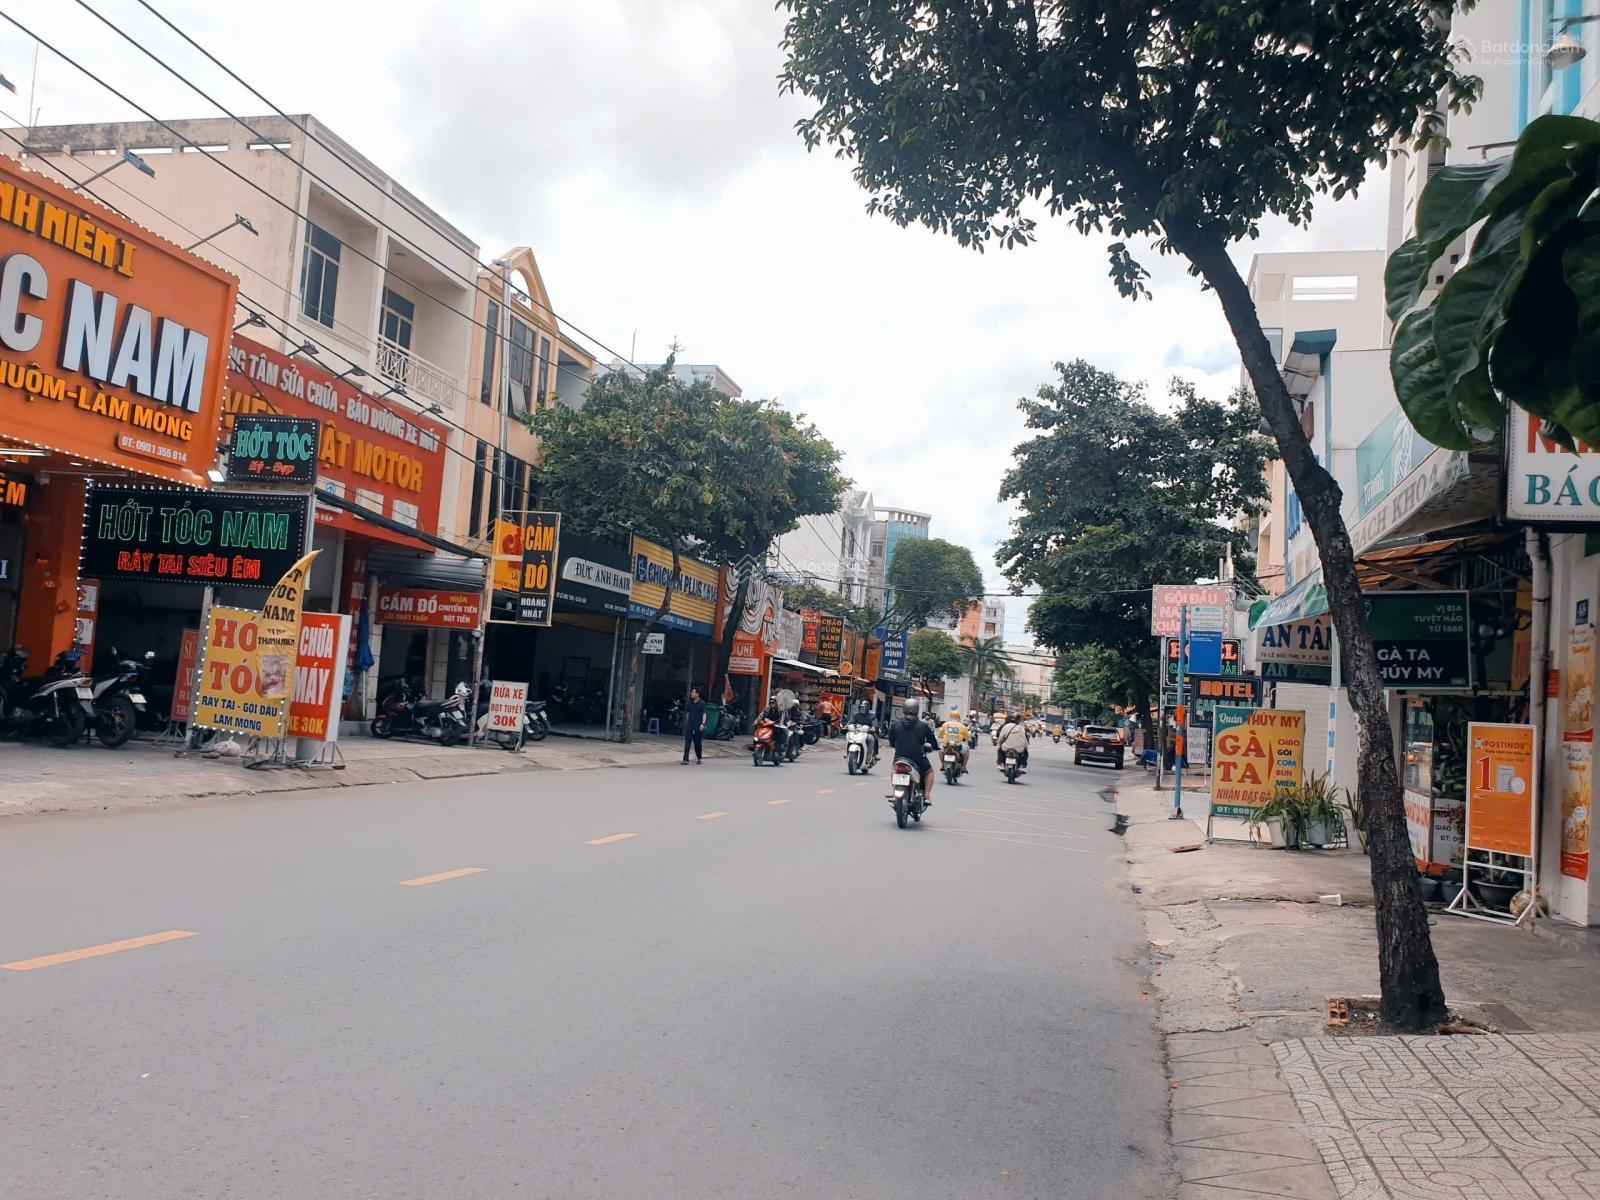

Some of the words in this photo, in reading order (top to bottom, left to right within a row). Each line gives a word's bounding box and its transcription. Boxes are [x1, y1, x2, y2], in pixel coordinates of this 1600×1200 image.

[62, 277, 209, 414] NAM
[250, 353, 278, 388] TÂM
[405, 423, 418, 445] XE
[235, 423, 272, 459] HỚT
[276, 424, 312, 461] TÓC
[353, 439, 424, 493] MOTOR
[98, 499, 154, 542] HỚT
[160, 501, 213, 546] TÓC
[220, 510, 290, 550] NAM
[525, 516, 555, 551] CẦM
[158, 553, 184, 575] TAI
[524, 554, 548, 589] ĐỒ
[595, 569, 612, 585] ANH
[612, 572, 631, 591] HAIR
[263, 605, 295, 622] NAM
[1262, 624, 1293, 648] AN
[1376, 646, 1403, 661] GÀ
[1406, 648, 1431, 661] TA
[290, 661, 330, 706] MÁY
[1417, 667, 1444, 679] MY
[513, 688, 524, 699] XE
[1200, 680, 1254, 698] HOTEL
[221, 698, 236, 710] TAI
[301, 717, 324, 735] 30K
[494, 715, 517, 727] 30K
[1219, 712, 1242, 724] Quán
[1280, 715, 1301, 728] MY
[1218, 730, 1266, 758] GÀ
[1485, 740, 1525, 749] POSTINOR
[1217, 761, 1262, 784] TA
[1476, 755, 1495, 792] 1
